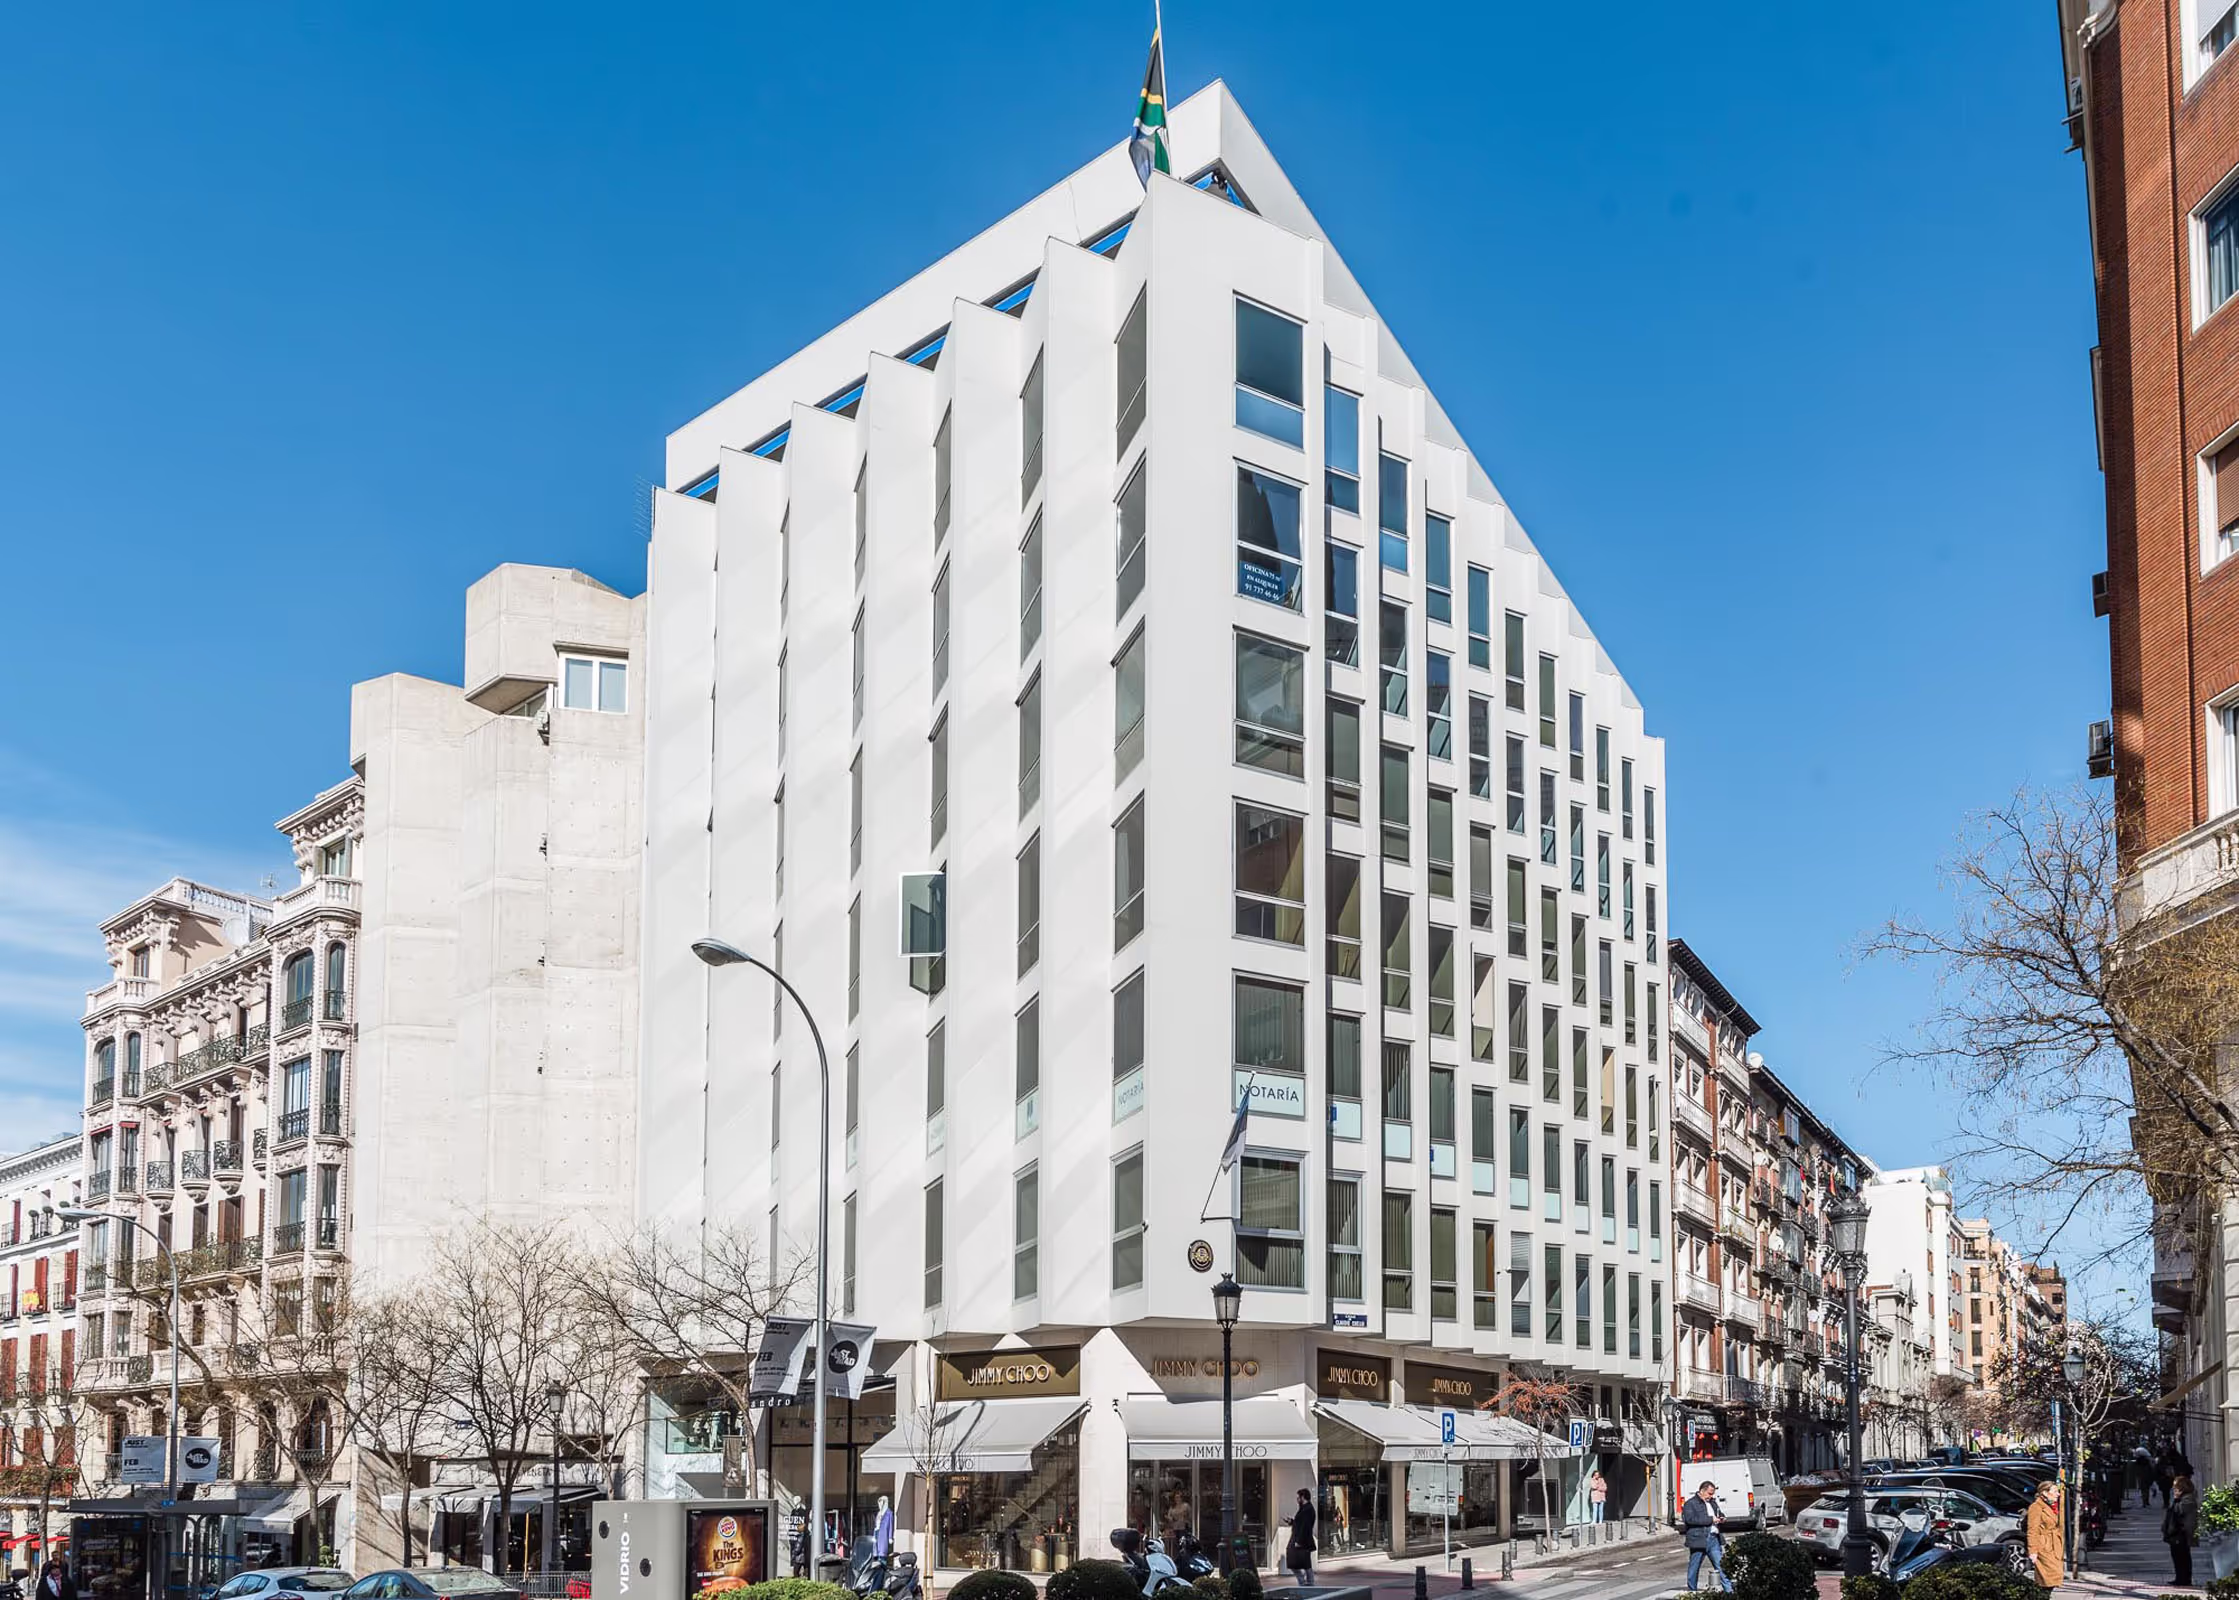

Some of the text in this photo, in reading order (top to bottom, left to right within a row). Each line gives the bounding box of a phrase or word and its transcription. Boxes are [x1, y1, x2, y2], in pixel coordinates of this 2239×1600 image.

[1239, 1084, 1299, 1102] NOTARÍA
[967, 1364, 1050, 1386] JIMMY CHOO
[1149, 1359, 1197, 1377] JIMMY
[1327, 1366, 1378, 1387] JIMMY CHOO
[1432, 1378, 1472, 1396] JIMMY CHOO
[750, 1397, 791, 1408] andro
[1444, 1415, 1453, 1440] P
[1573, 1423, 1581, 1445] P
[1184, 1446, 1268, 1459] JIMMY HOO
[619, 1531, 630, 1595] VIDRIO
[713, 1547, 744, 1562] KINGS
